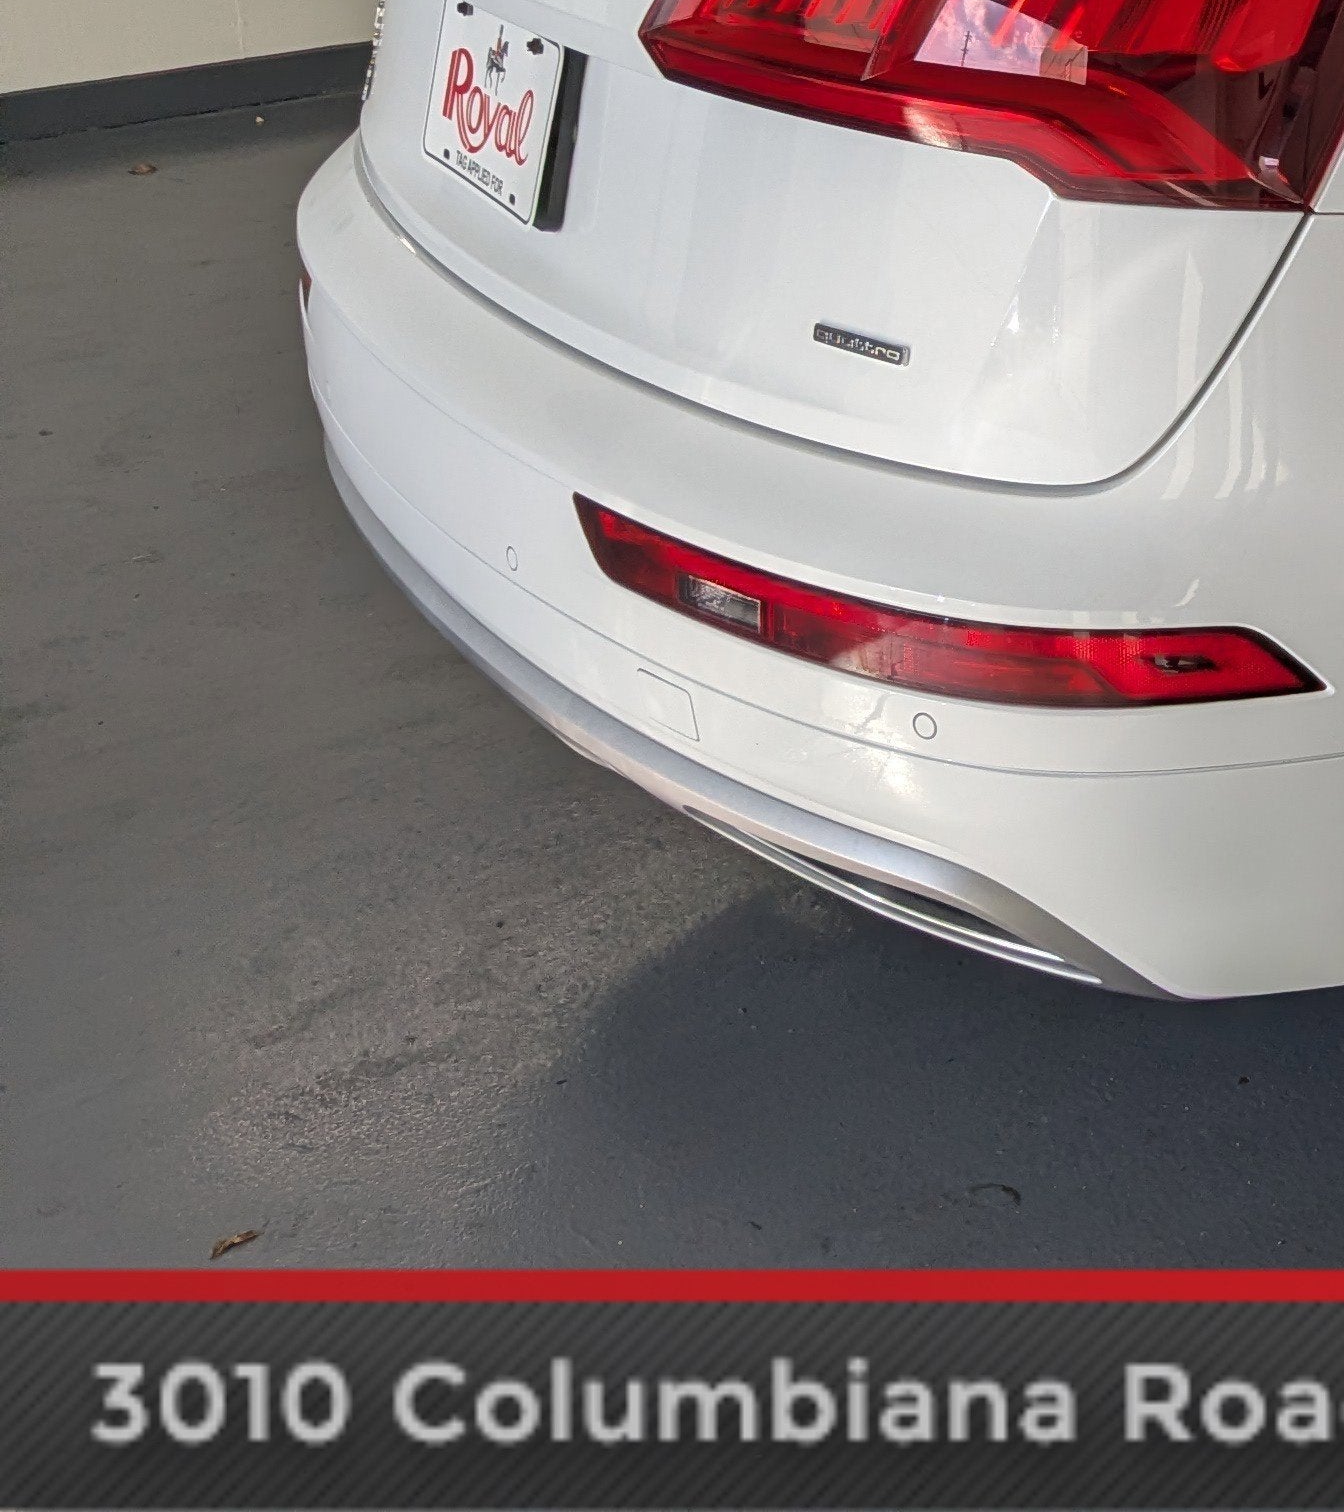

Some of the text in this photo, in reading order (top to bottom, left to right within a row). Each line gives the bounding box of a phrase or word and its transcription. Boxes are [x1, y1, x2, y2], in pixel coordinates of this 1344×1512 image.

[443, 48, 534, 167] Royal
[456, 150, 468, 170] TAG
[490, 175, 504, 196] FOR
